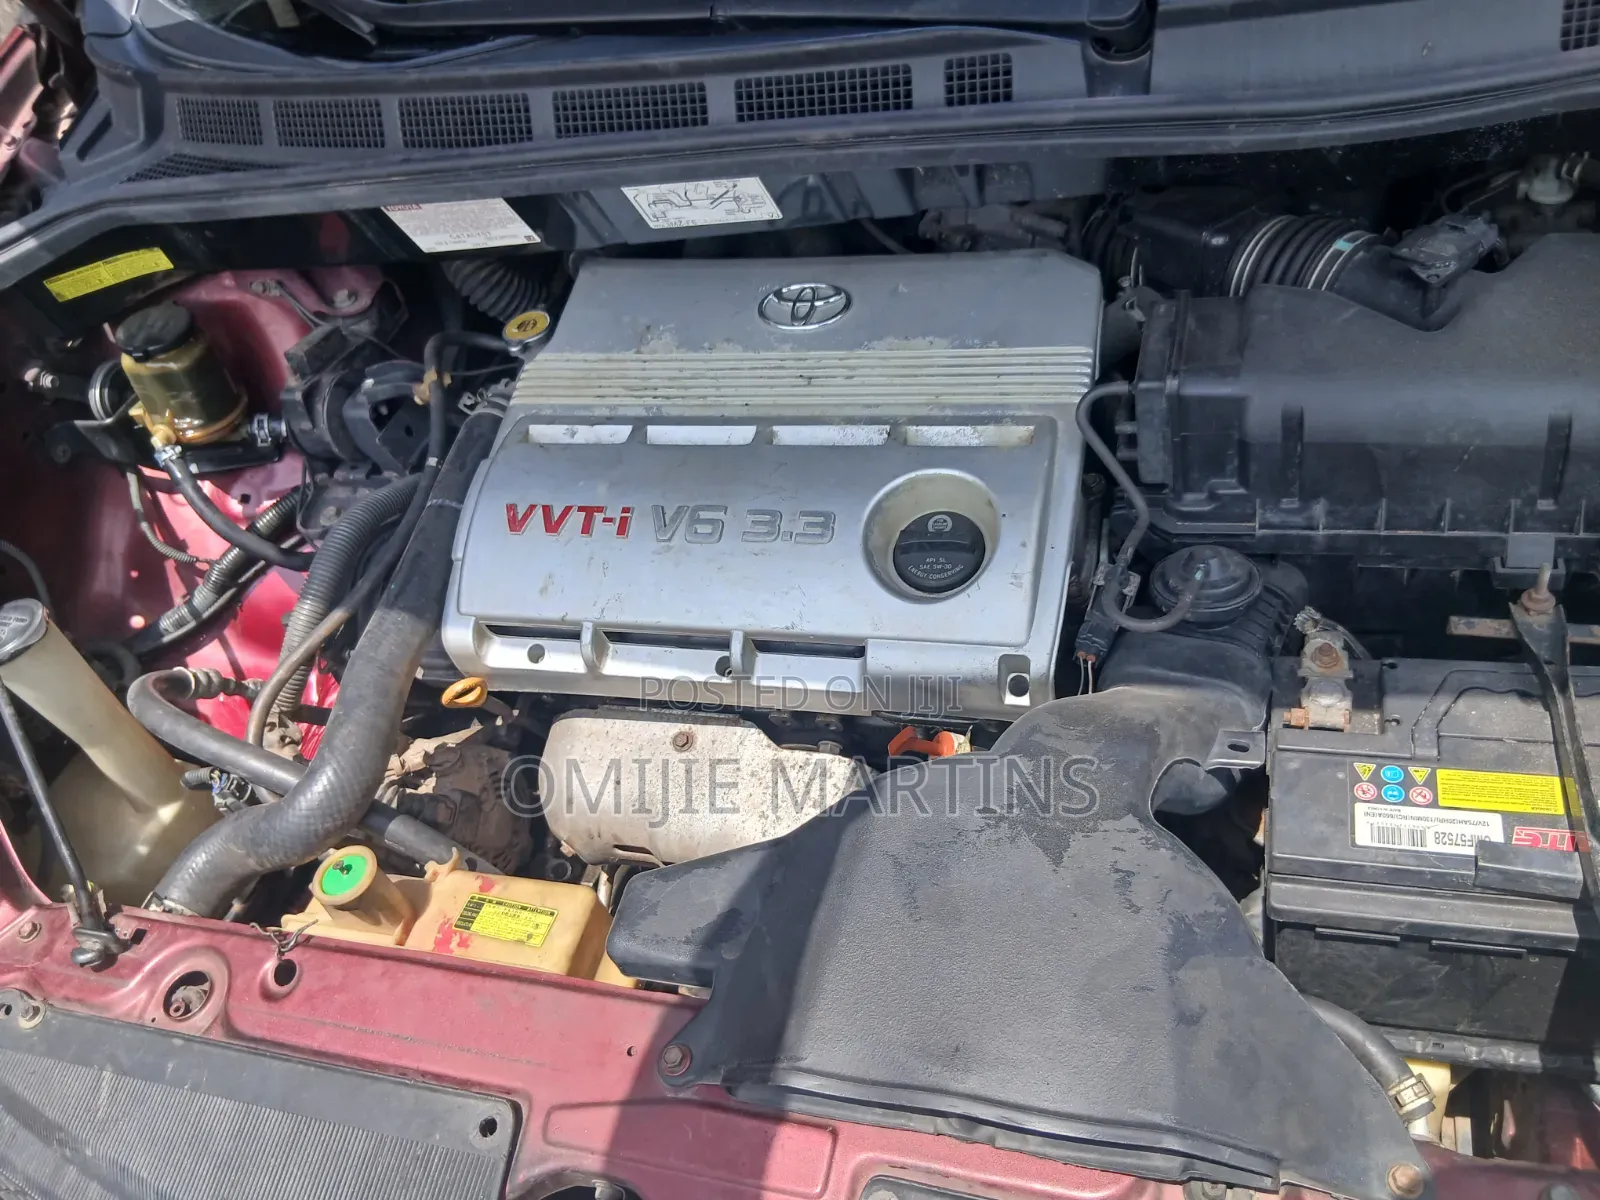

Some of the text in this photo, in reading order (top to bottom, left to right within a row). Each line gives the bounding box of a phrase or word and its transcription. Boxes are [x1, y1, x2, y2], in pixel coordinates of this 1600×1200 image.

[504, 503, 836, 545] VVT-i V6 3.3
[908, 565, 964, 579] ENERGY CONSERVING
